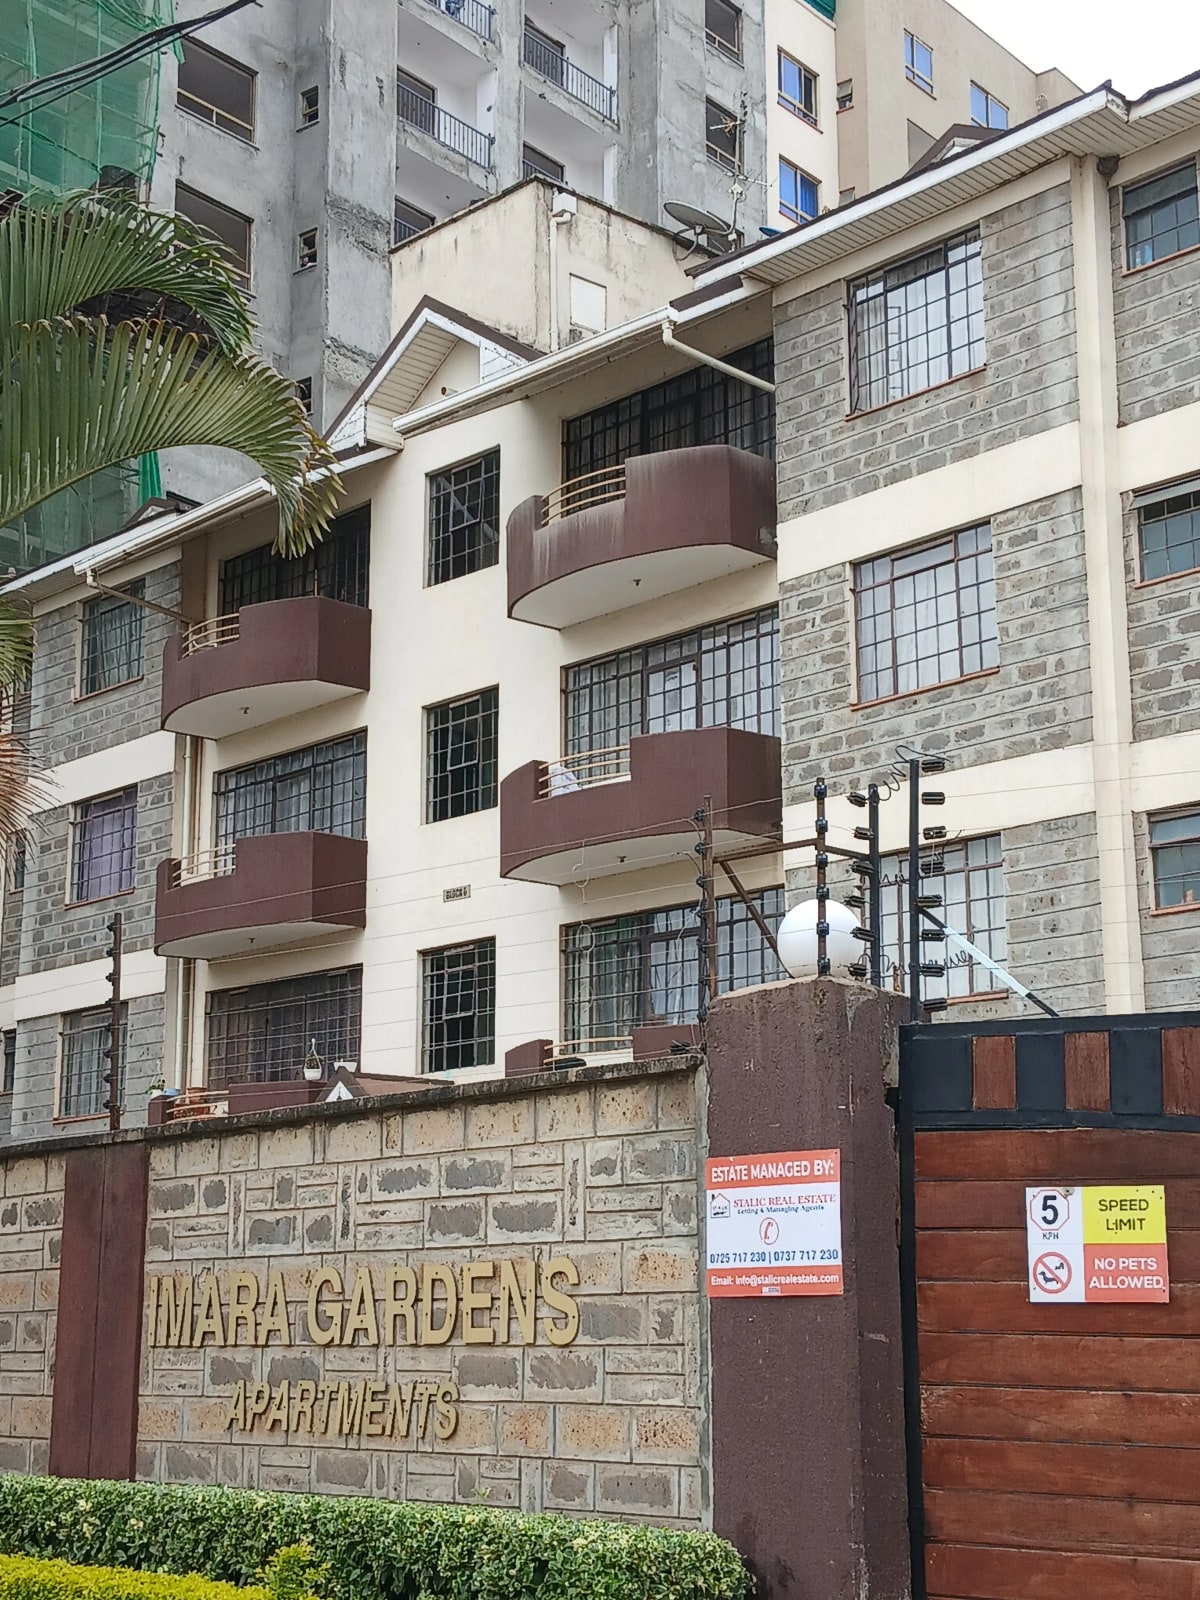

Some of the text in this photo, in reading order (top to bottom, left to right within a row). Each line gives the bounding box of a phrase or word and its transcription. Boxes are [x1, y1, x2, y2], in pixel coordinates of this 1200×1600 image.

[711, 1159, 835, 1182] ESTATE MANAGED BY:
[733, 1198, 767, 1208] STALIC
[768, 1196, 796, 1206] REAL
[797, 1194, 836, 1204] ESTATE
[1098, 1198, 1149, 1212] SPEED
[766, 1205, 799, 1214] Managing
[1041, 1195, 1059, 1225] 5
[1106, 1217, 1146, 1231] LIMIT
[1042, 1231, 1059, 1240] KPH
[710, 1253, 730, 1264] 0725
[732, 1252, 748, 1263] 717
[750, 1251, 766, 1263] 230
[773, 1250, 796, 1262] 0737
[799, 1249, 817, 1260] 717
[820, 1248, 839, 1260] 230
[1094, 1257, 1157, 1271] NO PETS
[711, 1275, 735, 1286] Email:
[149, 1257, 579, 1347] IMARA GARDENS
[226, 1379, 459, 1440] APARTMENTS
